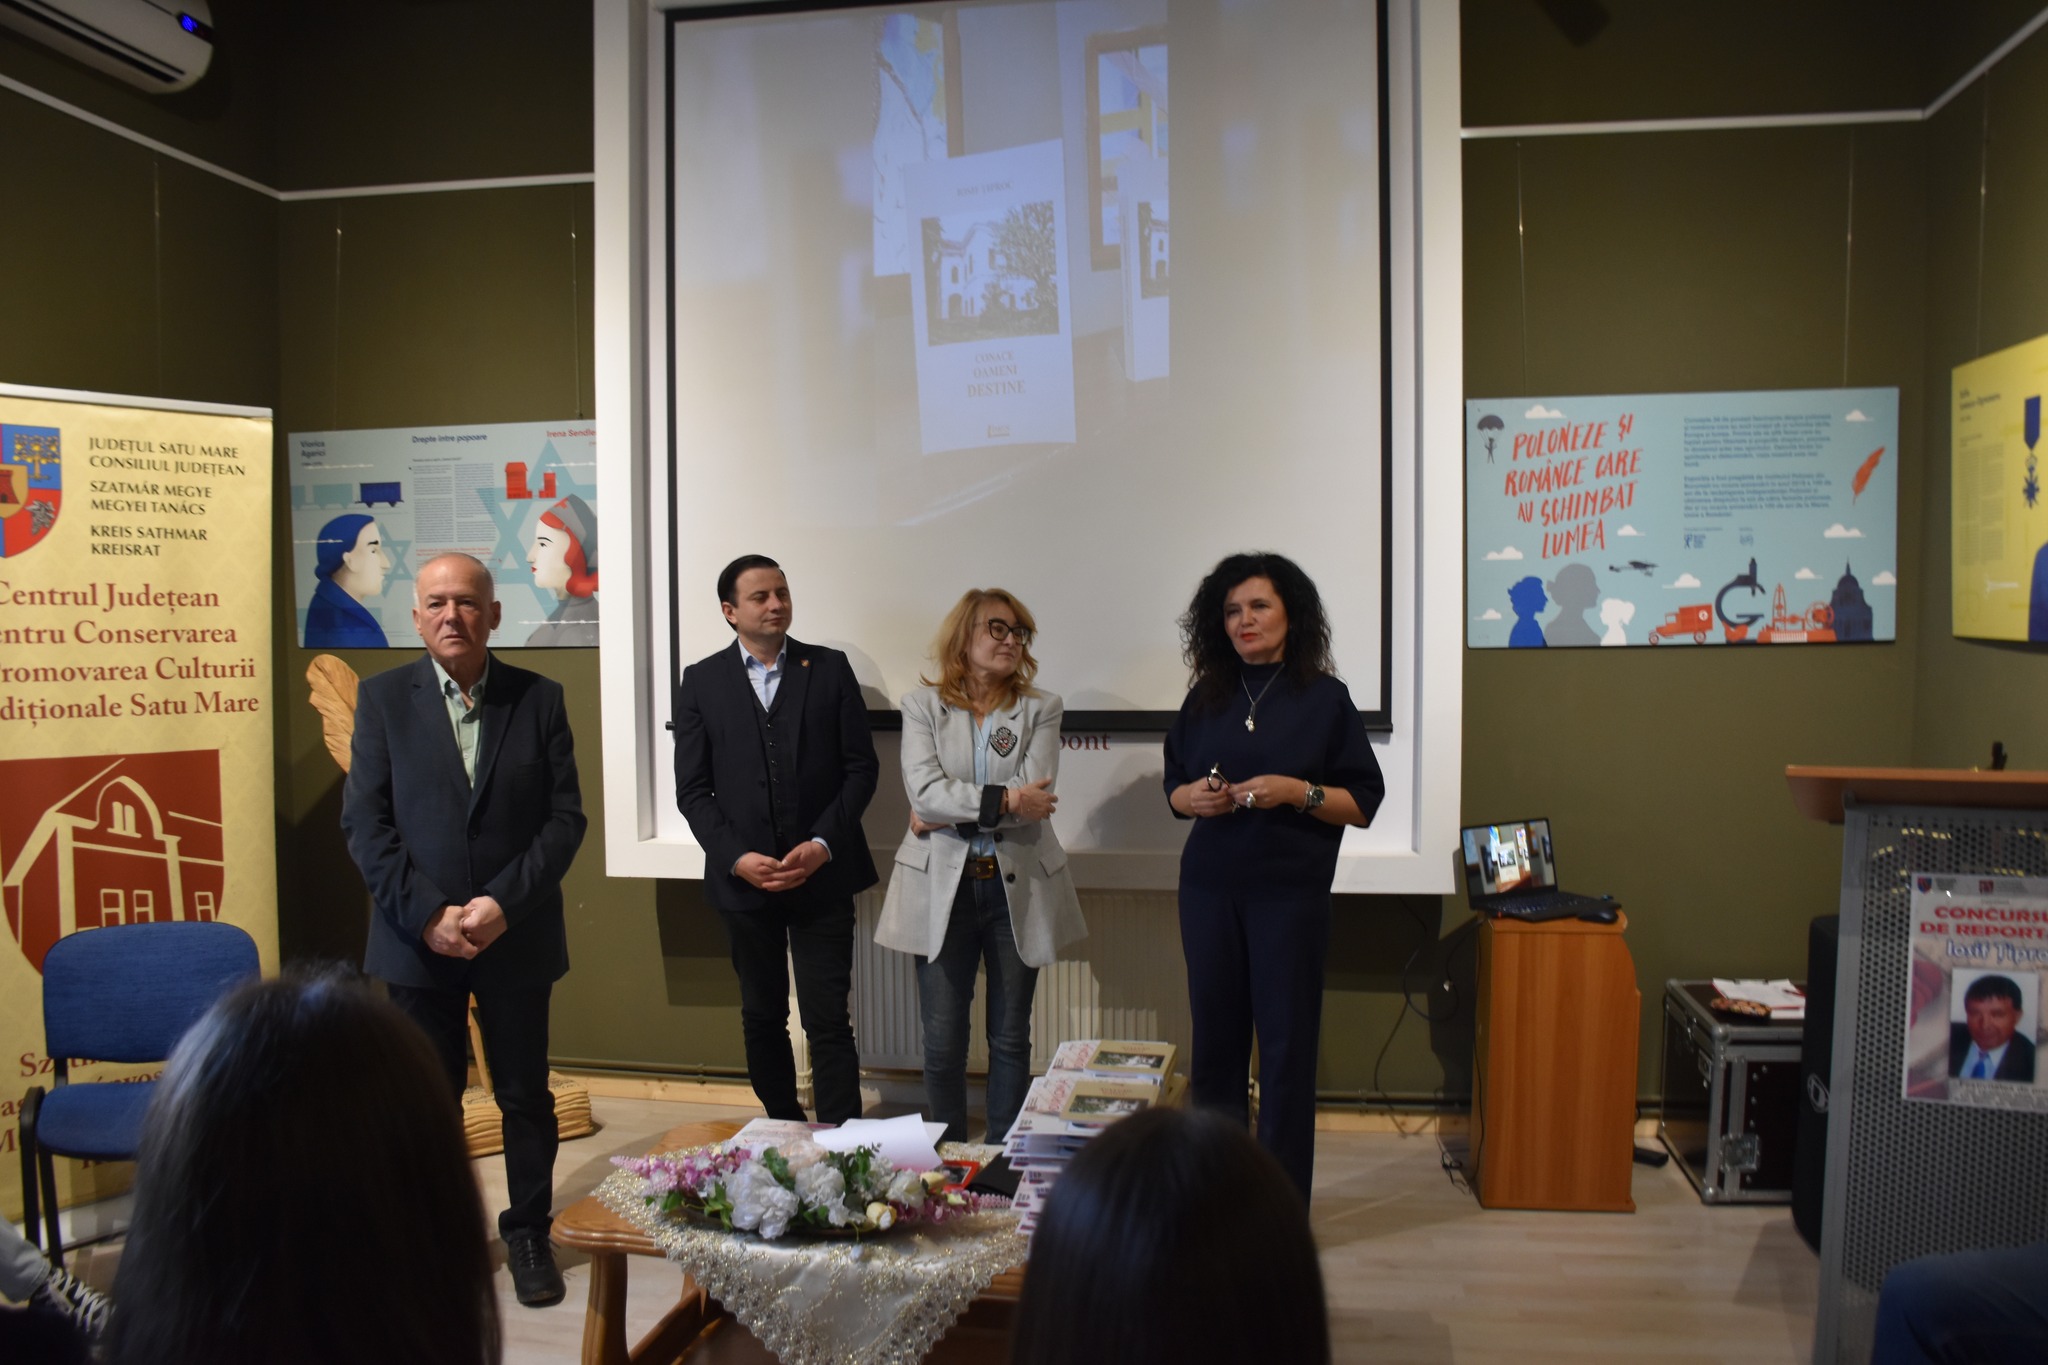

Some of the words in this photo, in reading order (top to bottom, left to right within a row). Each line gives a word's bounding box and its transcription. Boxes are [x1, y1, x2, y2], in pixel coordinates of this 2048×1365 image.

[967, 380, 1025, 398] DESTINE
[89, 436, 155, 455] JUDEȚUL
[158, 441, 197, 456] SATU
[199, 445, 240, 459] MARE
[1512, 420, 1609, 461] POLONEZE
[89, 454, 171, 472] CONSILIUL
[174, 460, 246, 477] JUDEȚEAN
[1504, 455, 1589, 497] ROMÂNCE
[1595, 447, 1644, 479] CARE
[90, 480, 160, 496] SZATMÁR
[163, 484, 213, 498] MEGYE
[90, 498, 147, 512] MEGYEI
[150, 500, 206, 515] TANÁCS
[1517, 500, 1534, 523] AU
[1540, 479, 1639, 527] SCHIMBAT
[90, 525, 133, 538] KREIS
[136, 526, 208, 541] SATHMAR
[1541, 517, 1605, 559] LUMEA
[90, 543, 161, 556] KREISRAT
[102, 583, 220, 615] Județean
[74, 619, 238, 644] Conservarea
[0, 664, 148, 683] romovarea
[155, 656, 256, 680] Culturii
[130, 692, 188, 716] Satu
[193, 690, 260, 714] Mare
[1920, 922, 1949, 935] DE
[1956, 923, 2048, 939] REPORT
